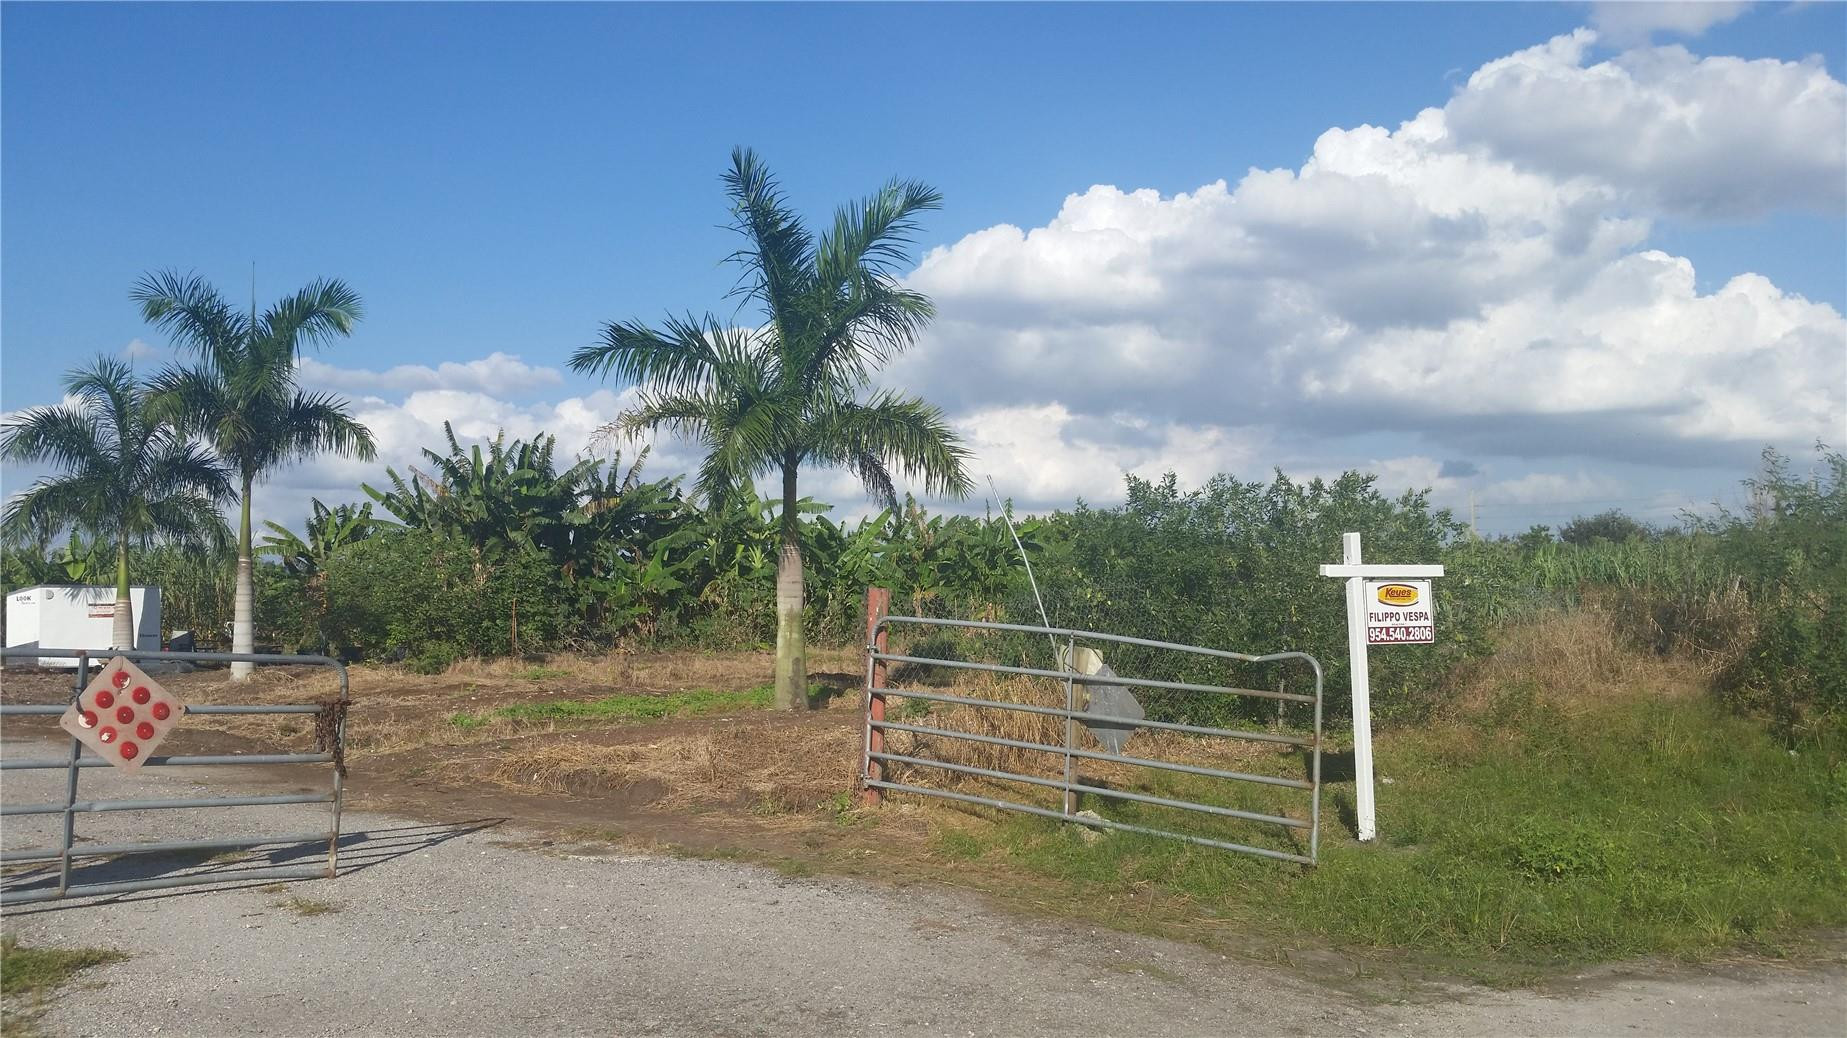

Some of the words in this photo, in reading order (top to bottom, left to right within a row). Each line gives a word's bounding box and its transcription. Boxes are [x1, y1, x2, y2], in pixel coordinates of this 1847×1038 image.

[1385, 587, 1412, 597] Keyes
[1369, 611, 1401, 622] FILIPPO
[1402, 611, 1430, 621] VESPA
[1369, 627, 1432, 641] 954.540.2806
